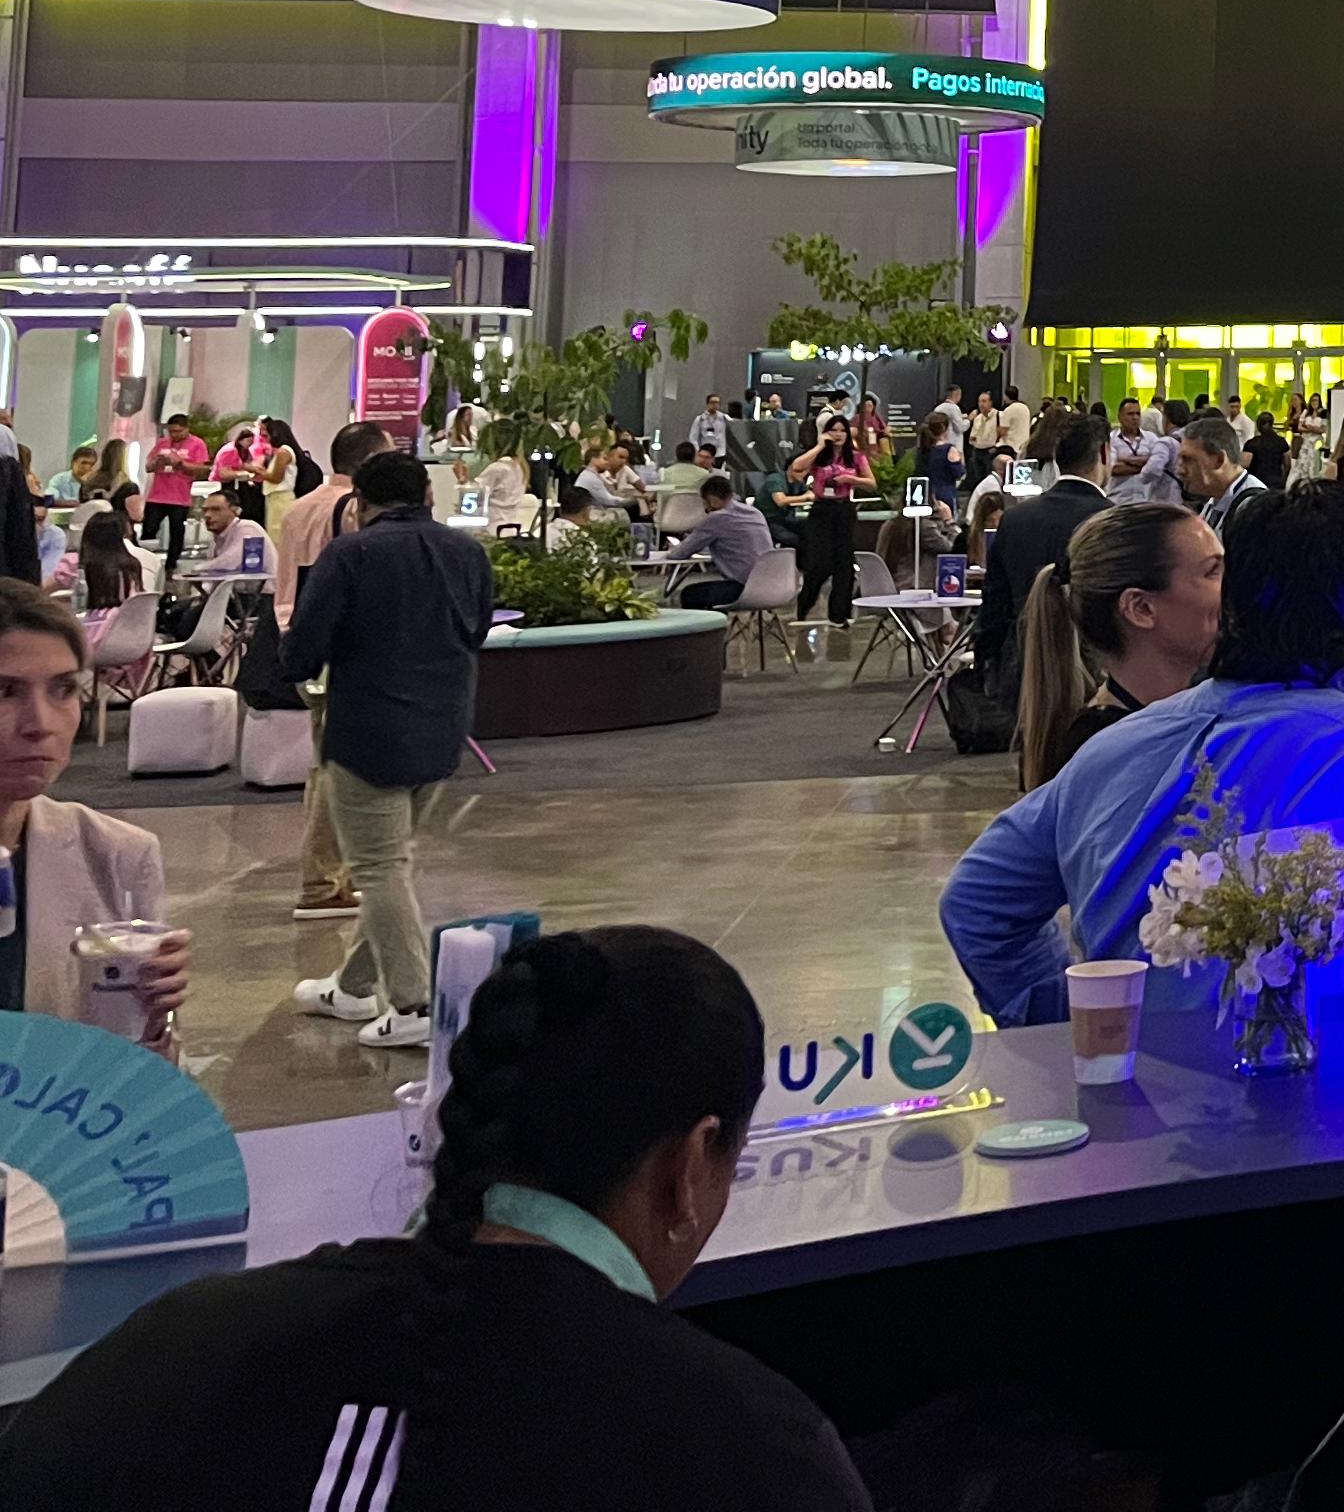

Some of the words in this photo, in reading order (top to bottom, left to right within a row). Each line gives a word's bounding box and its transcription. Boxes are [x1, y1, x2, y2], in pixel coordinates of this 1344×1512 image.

[686, 65, 797, 95] operación
[802, 66, 893, 94] global.
[912, 67, 982, 97] Pagos
[460, 492, 478, 514] 5
[912, 484, 924, 505] 4
